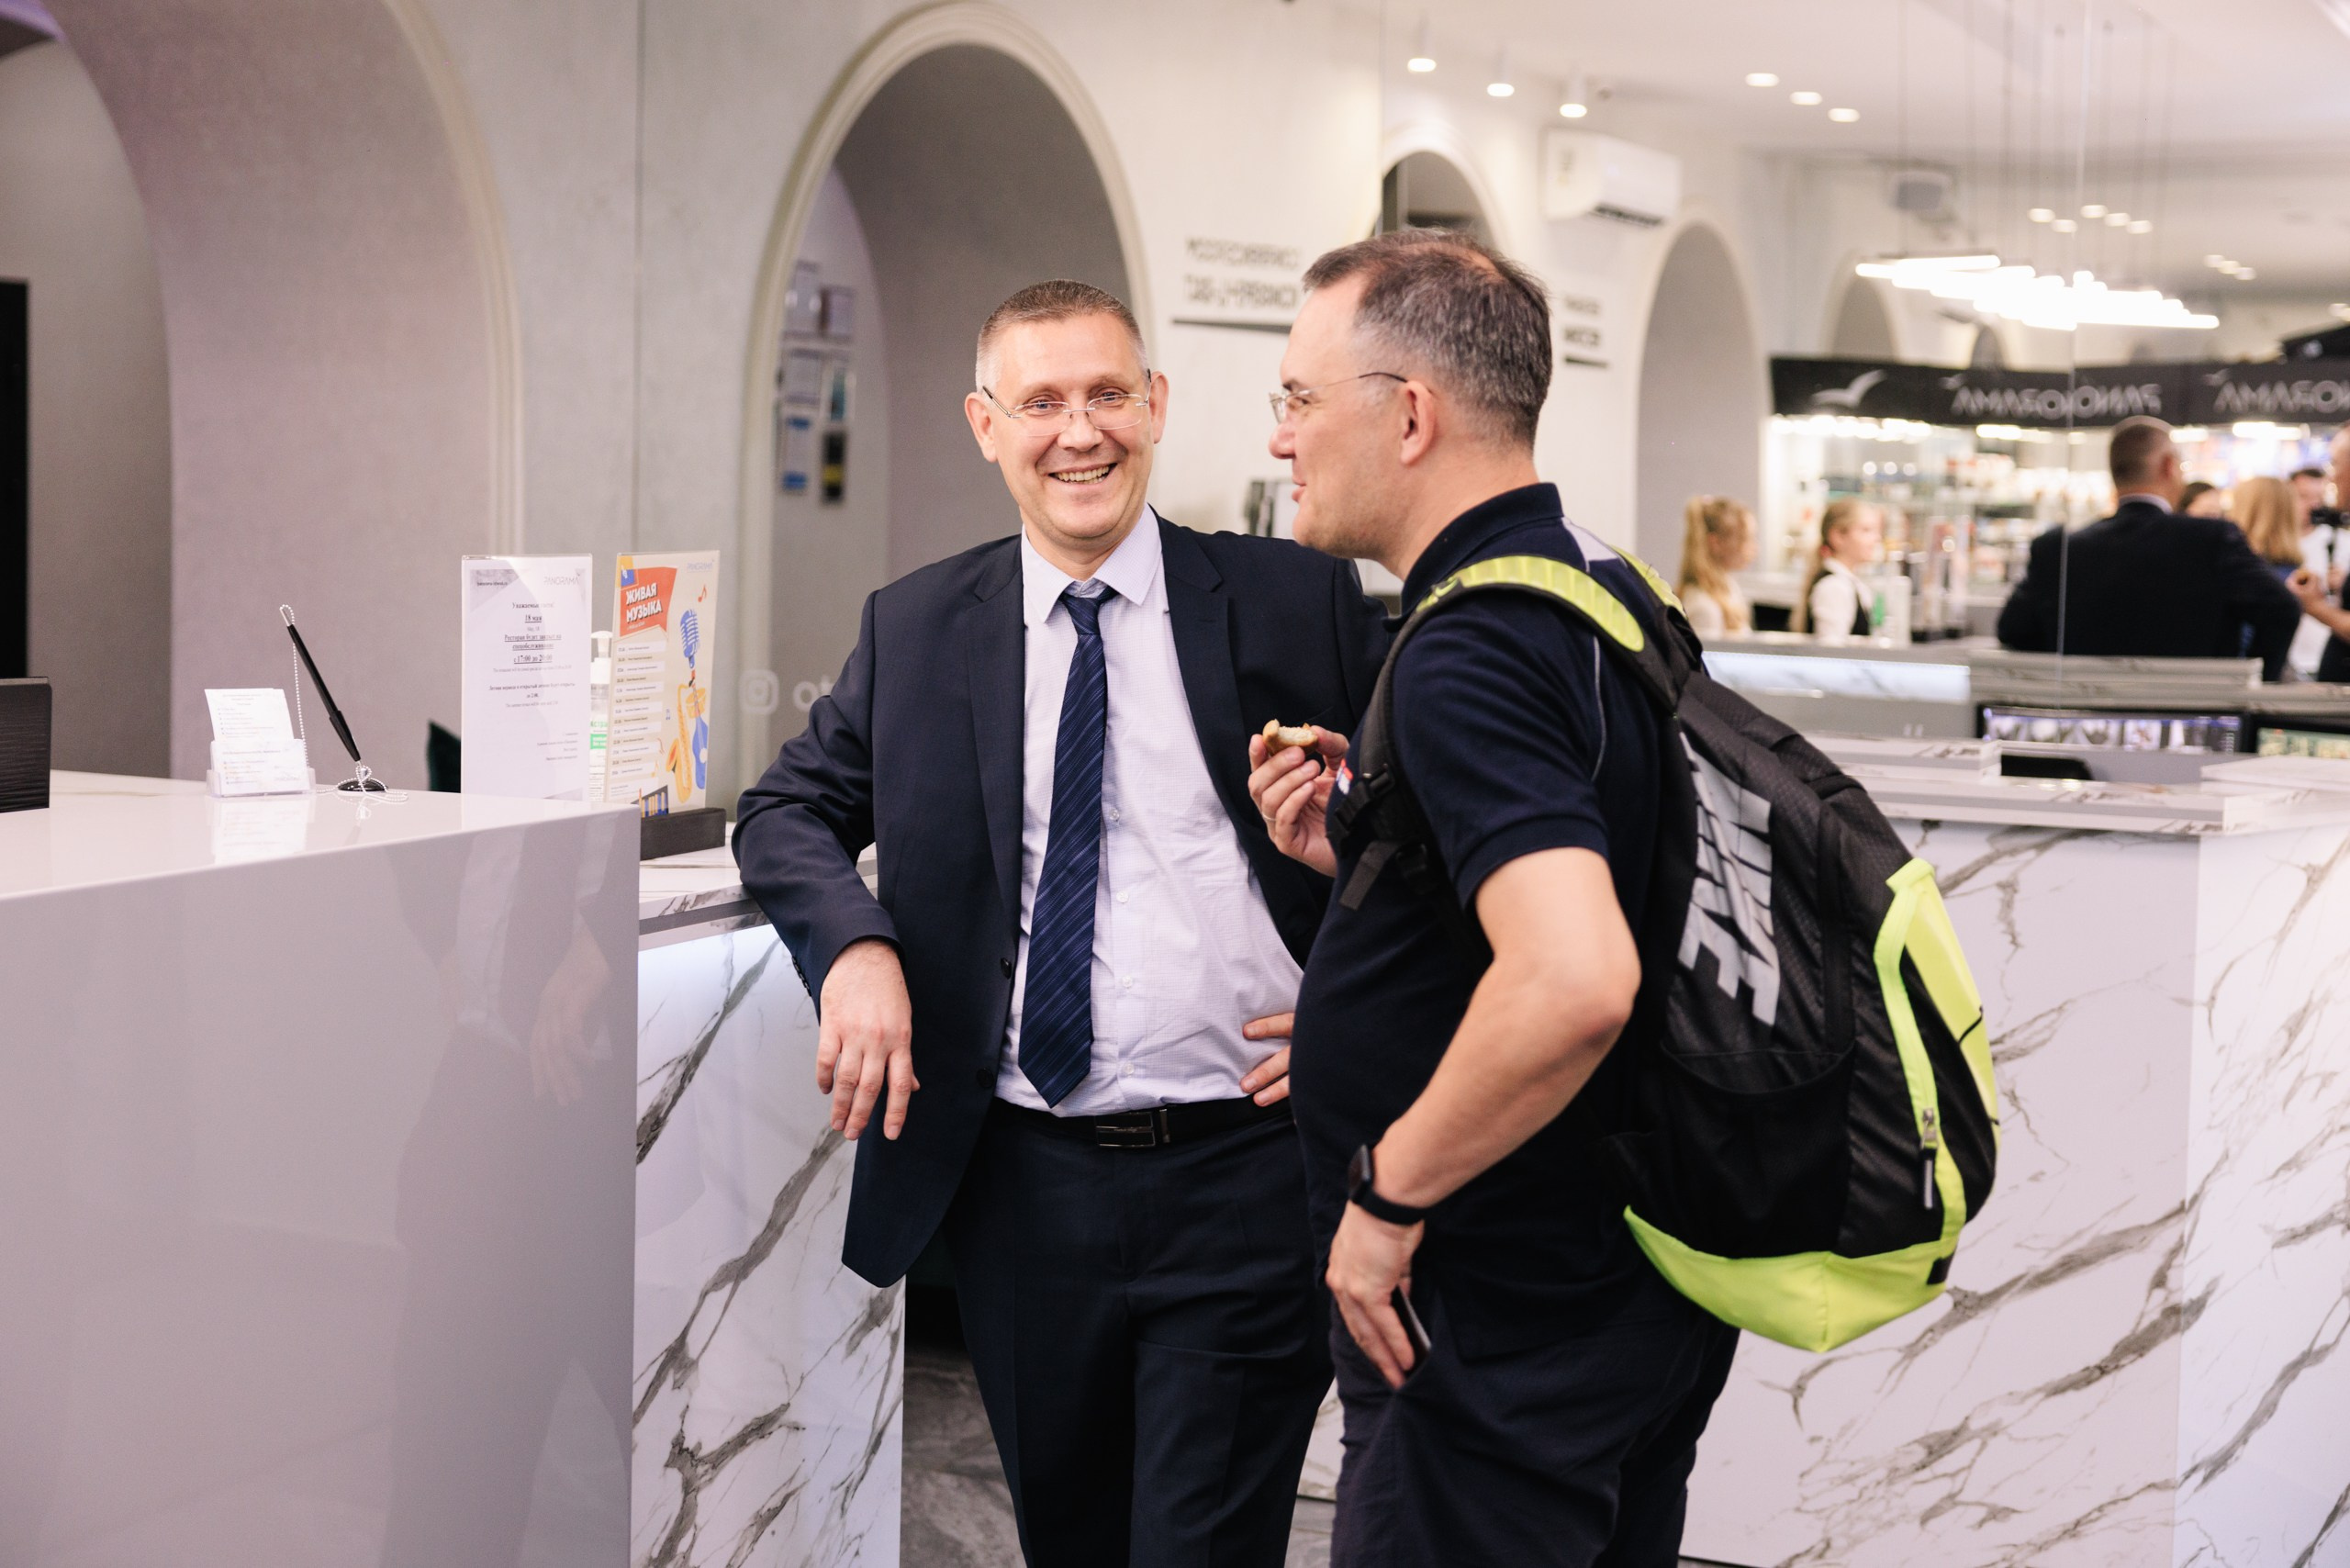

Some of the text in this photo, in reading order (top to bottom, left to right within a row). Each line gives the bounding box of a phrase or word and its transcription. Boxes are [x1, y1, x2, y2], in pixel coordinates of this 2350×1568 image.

[543, 576, 579, 587] PANORAMA
[625, 582, 657, 606] ЖИВАЯ
[626, 599, 663, 623] МУЗЫКА
[1677, 732, 1781, 1026] NIKE
